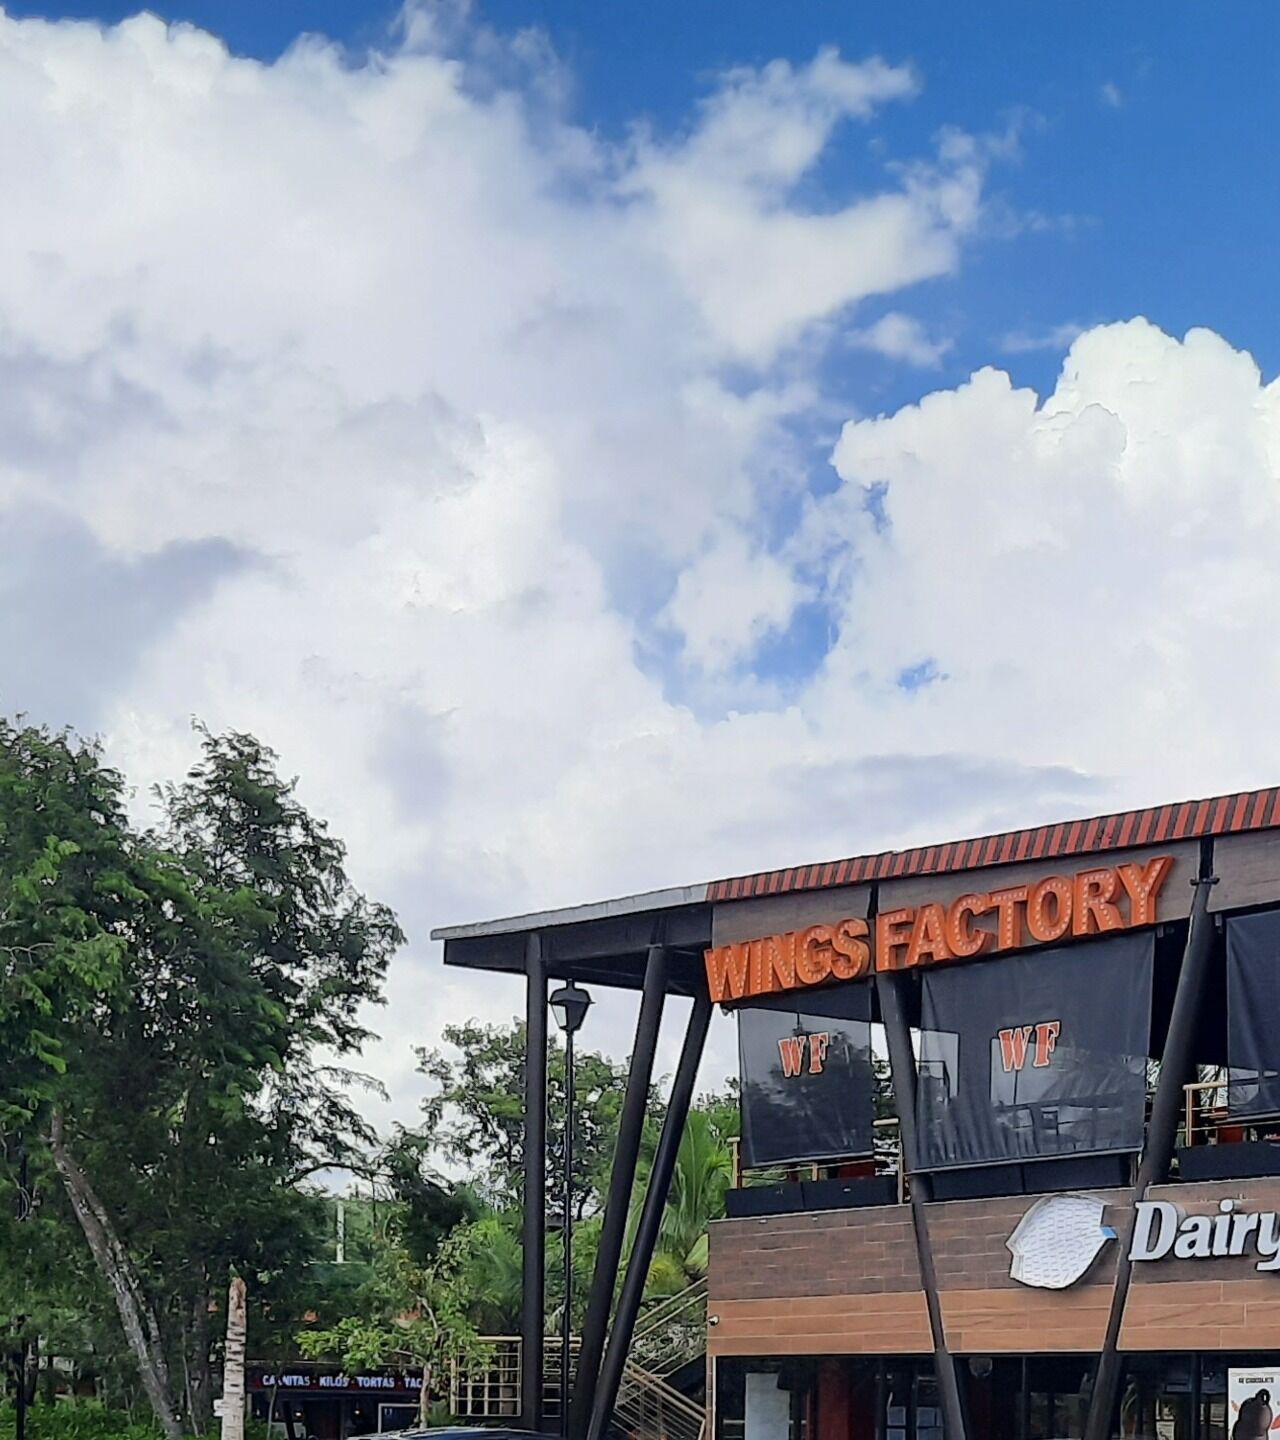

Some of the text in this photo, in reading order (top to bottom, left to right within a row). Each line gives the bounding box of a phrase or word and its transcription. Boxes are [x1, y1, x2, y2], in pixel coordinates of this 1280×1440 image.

[705, 857, 1174, 1004] WINGS FACTORY
[776, 1031, 830, 1079] WF
[996, 1021, 1061, 1073] WF
[320, 1376, 350, 1387] KILOS
[356, 1376, 395, 1388] TORTAS
